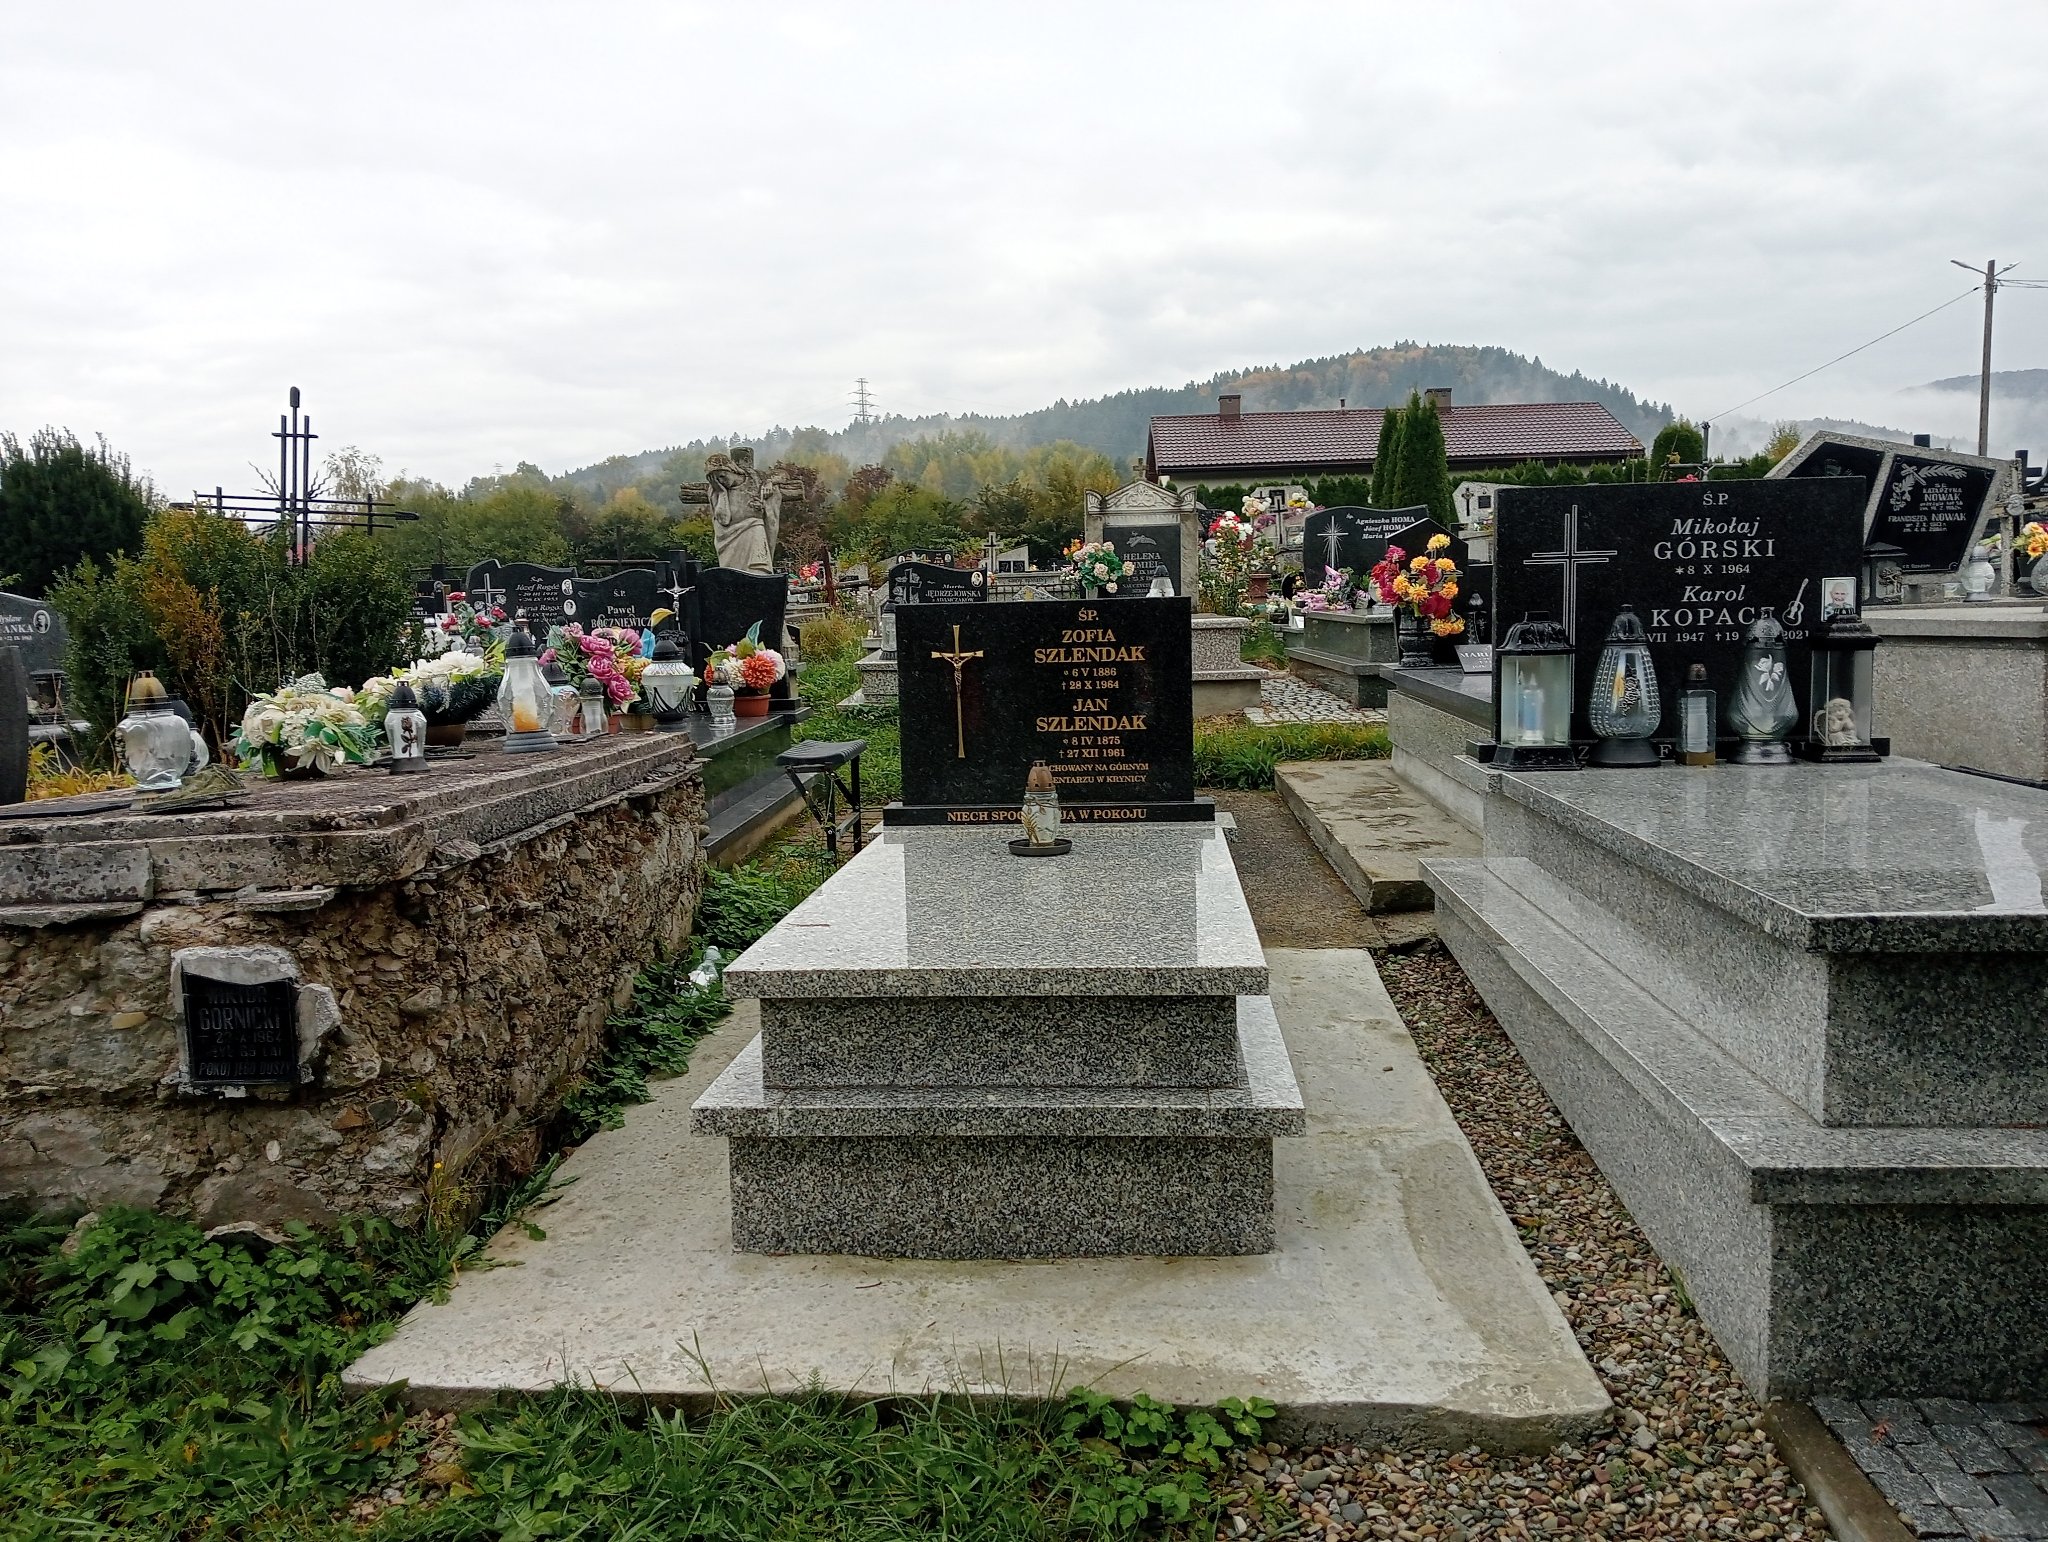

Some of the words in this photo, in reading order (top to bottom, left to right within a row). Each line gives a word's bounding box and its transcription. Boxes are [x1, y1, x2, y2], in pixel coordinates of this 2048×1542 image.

[1924, 493, 1961, 502] NOWAK
[1931, 512, 1967, 521] NOWAK
[1355, 518, 1390, 526] Agnieszka
[1670, 516, 1761, 537] Mikołaj
[1653, 536, 1776, 560] GÓRSKI
[1123, 552, 1161, 561] HELENA
[1703, 564, 1713, 575] X
[1721, 564, 1751, 574] 1964
[514, 584, 536, 592] Józef
[1681, 584, 1745, 602] Karol
[925, 590, 981, 599] JĘDRZEJOWSKA
[1061, 628, 1117, 643] ZOFIA
[1646, 632, 1668, 643] VII
[1675, 632, 1705, 642] 1947
[1034, 645, 1146, 664] SZLENDAK
[1071, 668, 1079, 677] 6
[1080, 667, 1090, 677] V
[1092, 667, 1117, 677] 1886
[1069, 680, 1082, 690] 28
[1084, 680, 1093, 690] X
[1095, 680, 1120, 689] 1964
[1072, 698, 1109, 712] JAN
[1036, 714, 1147, 732] SZLENDAK
[1071, 736, 1079, 746] 8
[1080, 736, 1094, 746] IV
[1096, 736, 1121, 745] 1875
[1066, 749, 1080, 758] 27
[1081, 748, 1099, 758] XII
[1102, 748, 1126, 757] 1961
[1049, 764, 1093, 772] CHOWANY
[1094, 764, 1108, 772] NA
[1109, 762, 1149, 771] GÓRNYM
[1053, 776, 1095, 784] ENTARZU
[1096, 776, 1106, 784] W
[1106, 775, 1147, 783] KRYNICY
[947, 811, 989, 822] NIECH
[1080, 809, 1091, 820] W
[1093, 808, 1147, 820] POKOJU
